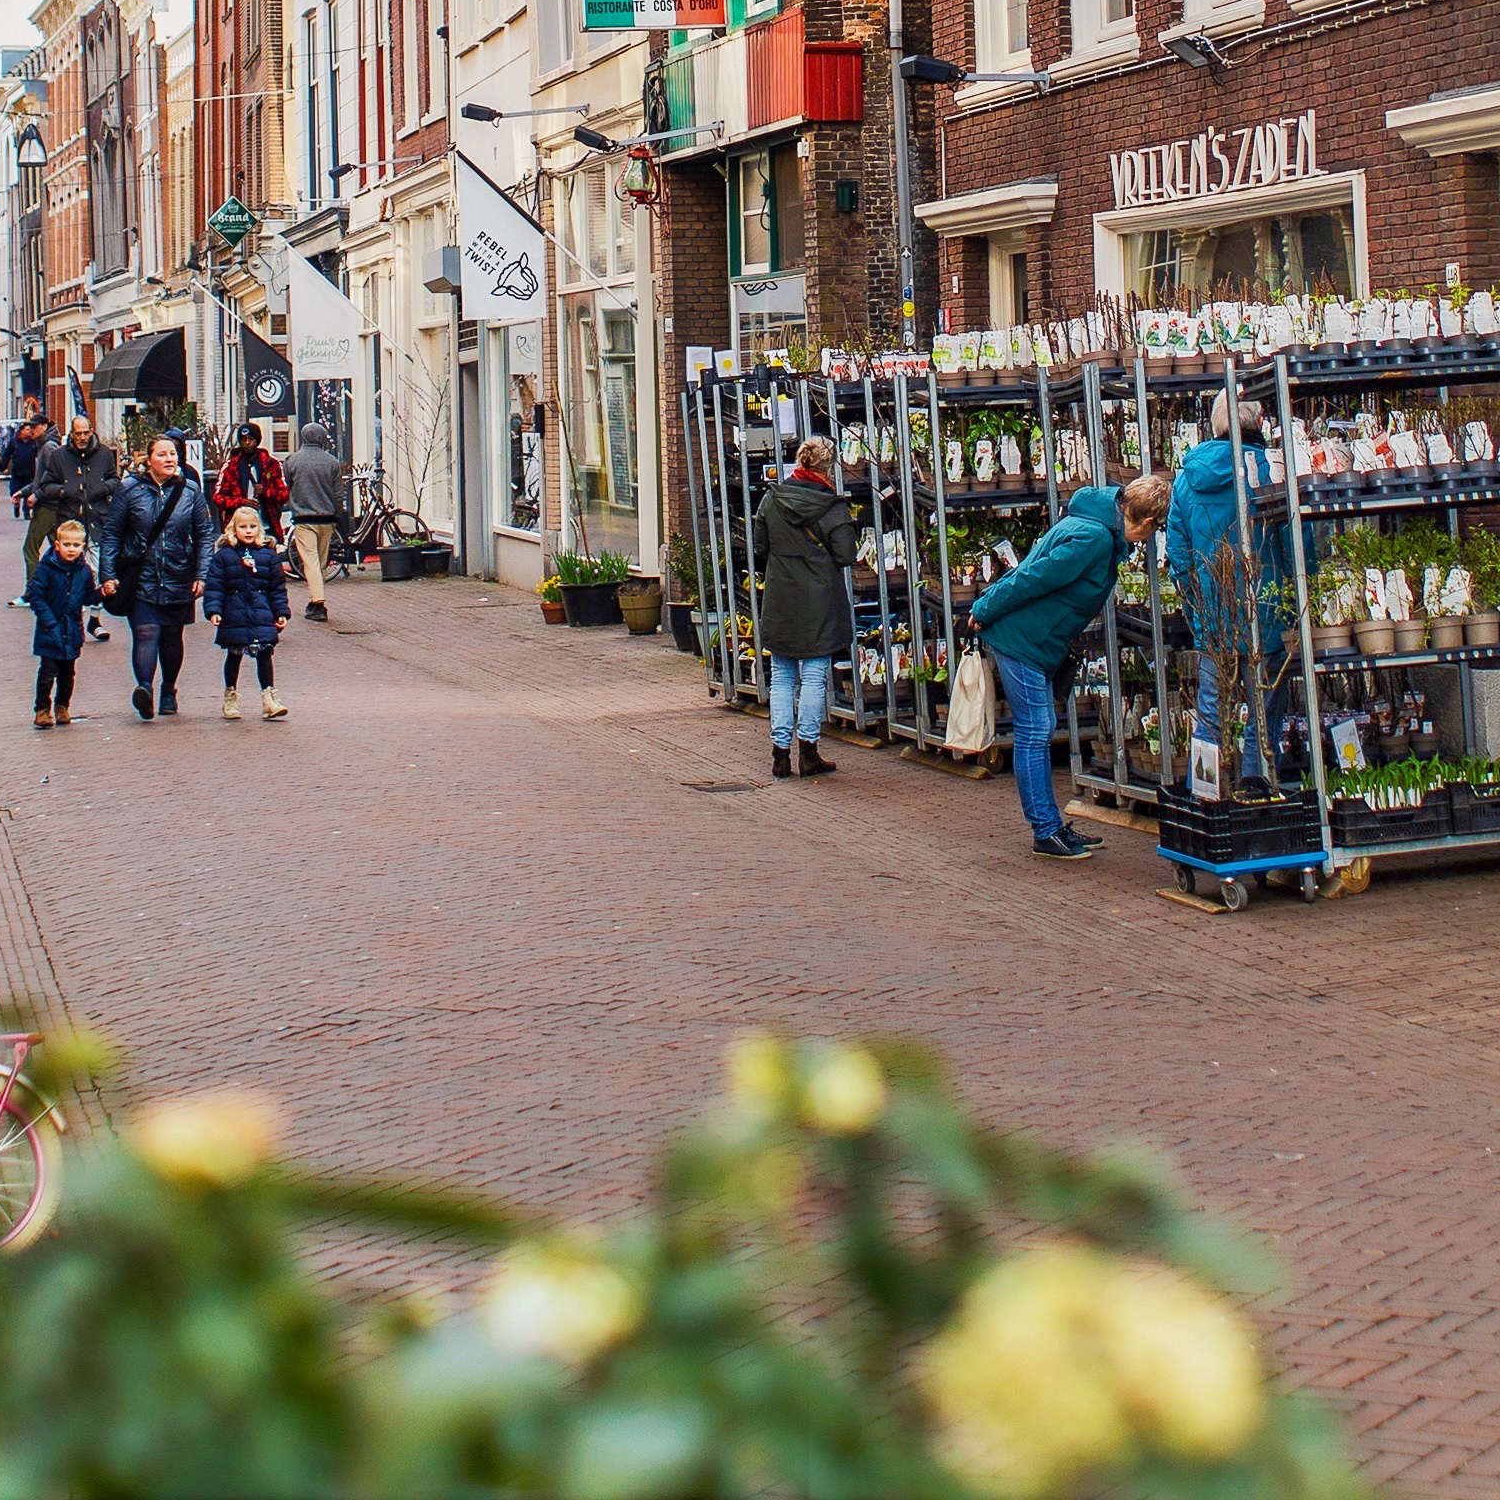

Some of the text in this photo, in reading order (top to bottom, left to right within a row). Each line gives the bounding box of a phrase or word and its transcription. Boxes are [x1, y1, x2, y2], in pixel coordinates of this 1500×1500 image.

[587, 0, 646, 14] RISTORANTE
[1110, 109, 1320, 210] VREEKEN'S ZADEN
[217, 212, 250, 223] Brand
[471, 240, 493, 260] WITH
[476, 230, 508, 261] REBEL
[464, 246, 497, 276] TWIST
